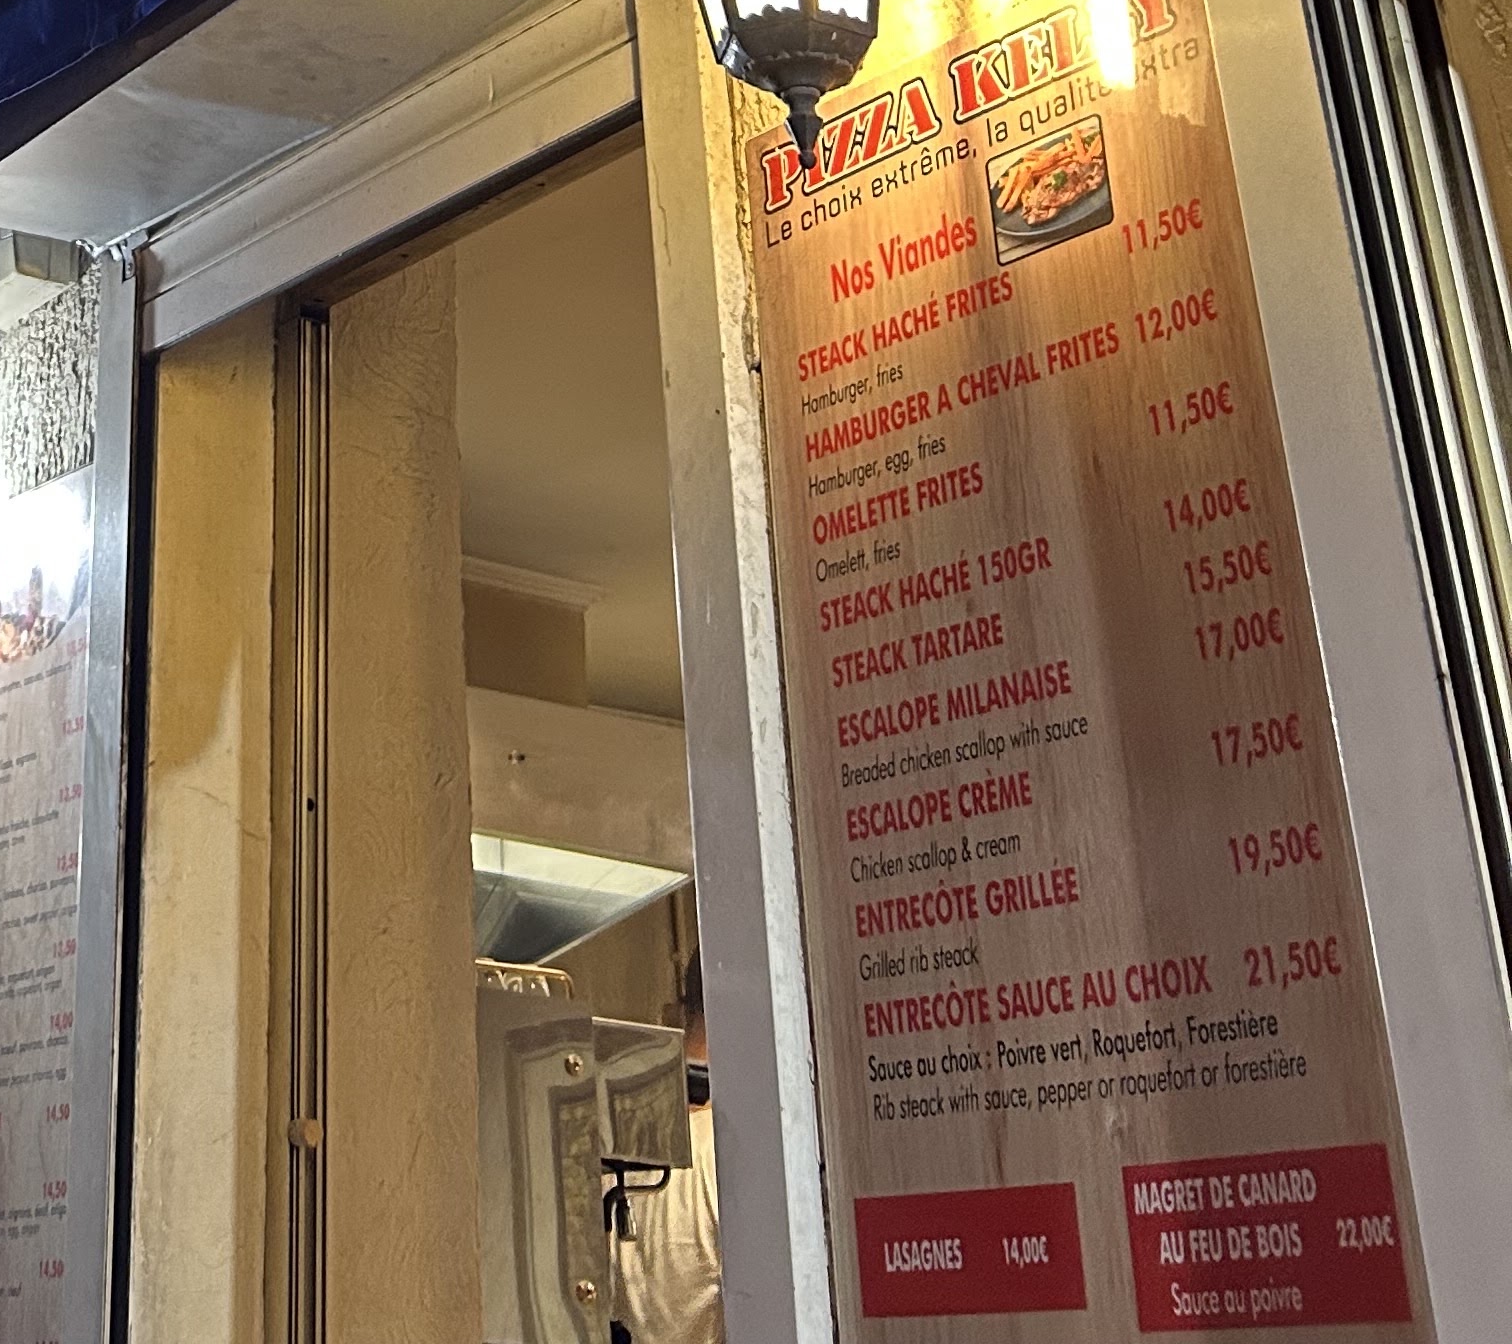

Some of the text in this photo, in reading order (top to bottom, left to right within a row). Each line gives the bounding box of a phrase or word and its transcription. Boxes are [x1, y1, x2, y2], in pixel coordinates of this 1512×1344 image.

[761, 77, 941, 214] PIZZA
[765, 219, 792, 249] Le
[801, 185, 863, 231] choix
[871, 137, 977, 198] extrême,
[986, 118, 1009, 148] la
[1134, 37, 1199, 82] xtra
[797, 198, 1204, 382] STEACK HACHÉ FRITES 11,50€
[830, 213, 978, 304] Nos Viandes
[801, 362, 904, 416] Hamburger, fries
[805, 288, 1218, 462] HAMBURGER A CHEVAL FRITES 12,00€
[808, 434, 946, 498] Hamburger, egg, fries
[813, 381, 1234, 545] OMELETTE FRITES 11,50€
[816, 538, 901, 583] Omelett, fries
[820, 478, 1251, 633] STEACK HACHÉ 150GR 14,00€
[831, 540, 1273, 688] STEACK TARTARE 15,50€
[838, 608, 1284, 748] ESCALOPE MILANAISE 17,00€
[841, 716, 1088, 787] Breaded chicken scallop with sauce
[847, 713, 1303, 841] ESCALOPE CRÈME 17,50€
[850, 834, 1021, 883] Chicken scallop & cream
[855, 822, 1323, 938] ENTRECÔTE GRILLÉE 19,50€
[859, 936, 979, 981] Grilled rib steack
[864, 935, 1341, 1038] ENTRECÔTE SAUCE AU CHOIX 21,50€
[868, 1055, 913, 1082] Sauce
[917, 1057, 936, 1077] au
[941, 1044, 983, 1074] choix
[997, 1038, 1046, 1069] Poivre
[1050, 1033, 1088, 1064] vert,
[1092, 1020, 1183, 1062] Roquefort,
[1186, 1009, 1278, 1045] Forestière
[873, 1048, 1307, 1121] Rib steack with sauce, pepper or roquefort or forestière
[1134, 1168, 1317, 1215] MAGRET DE CANARD
[884, 1236, 1049, 1272] LASAGNES 14,00€
[1160, 1216, 1394, 1264] AU FEU DE BOIS 22,00€
[1170, 1276, 1303, 1321] Sauce au poivre
